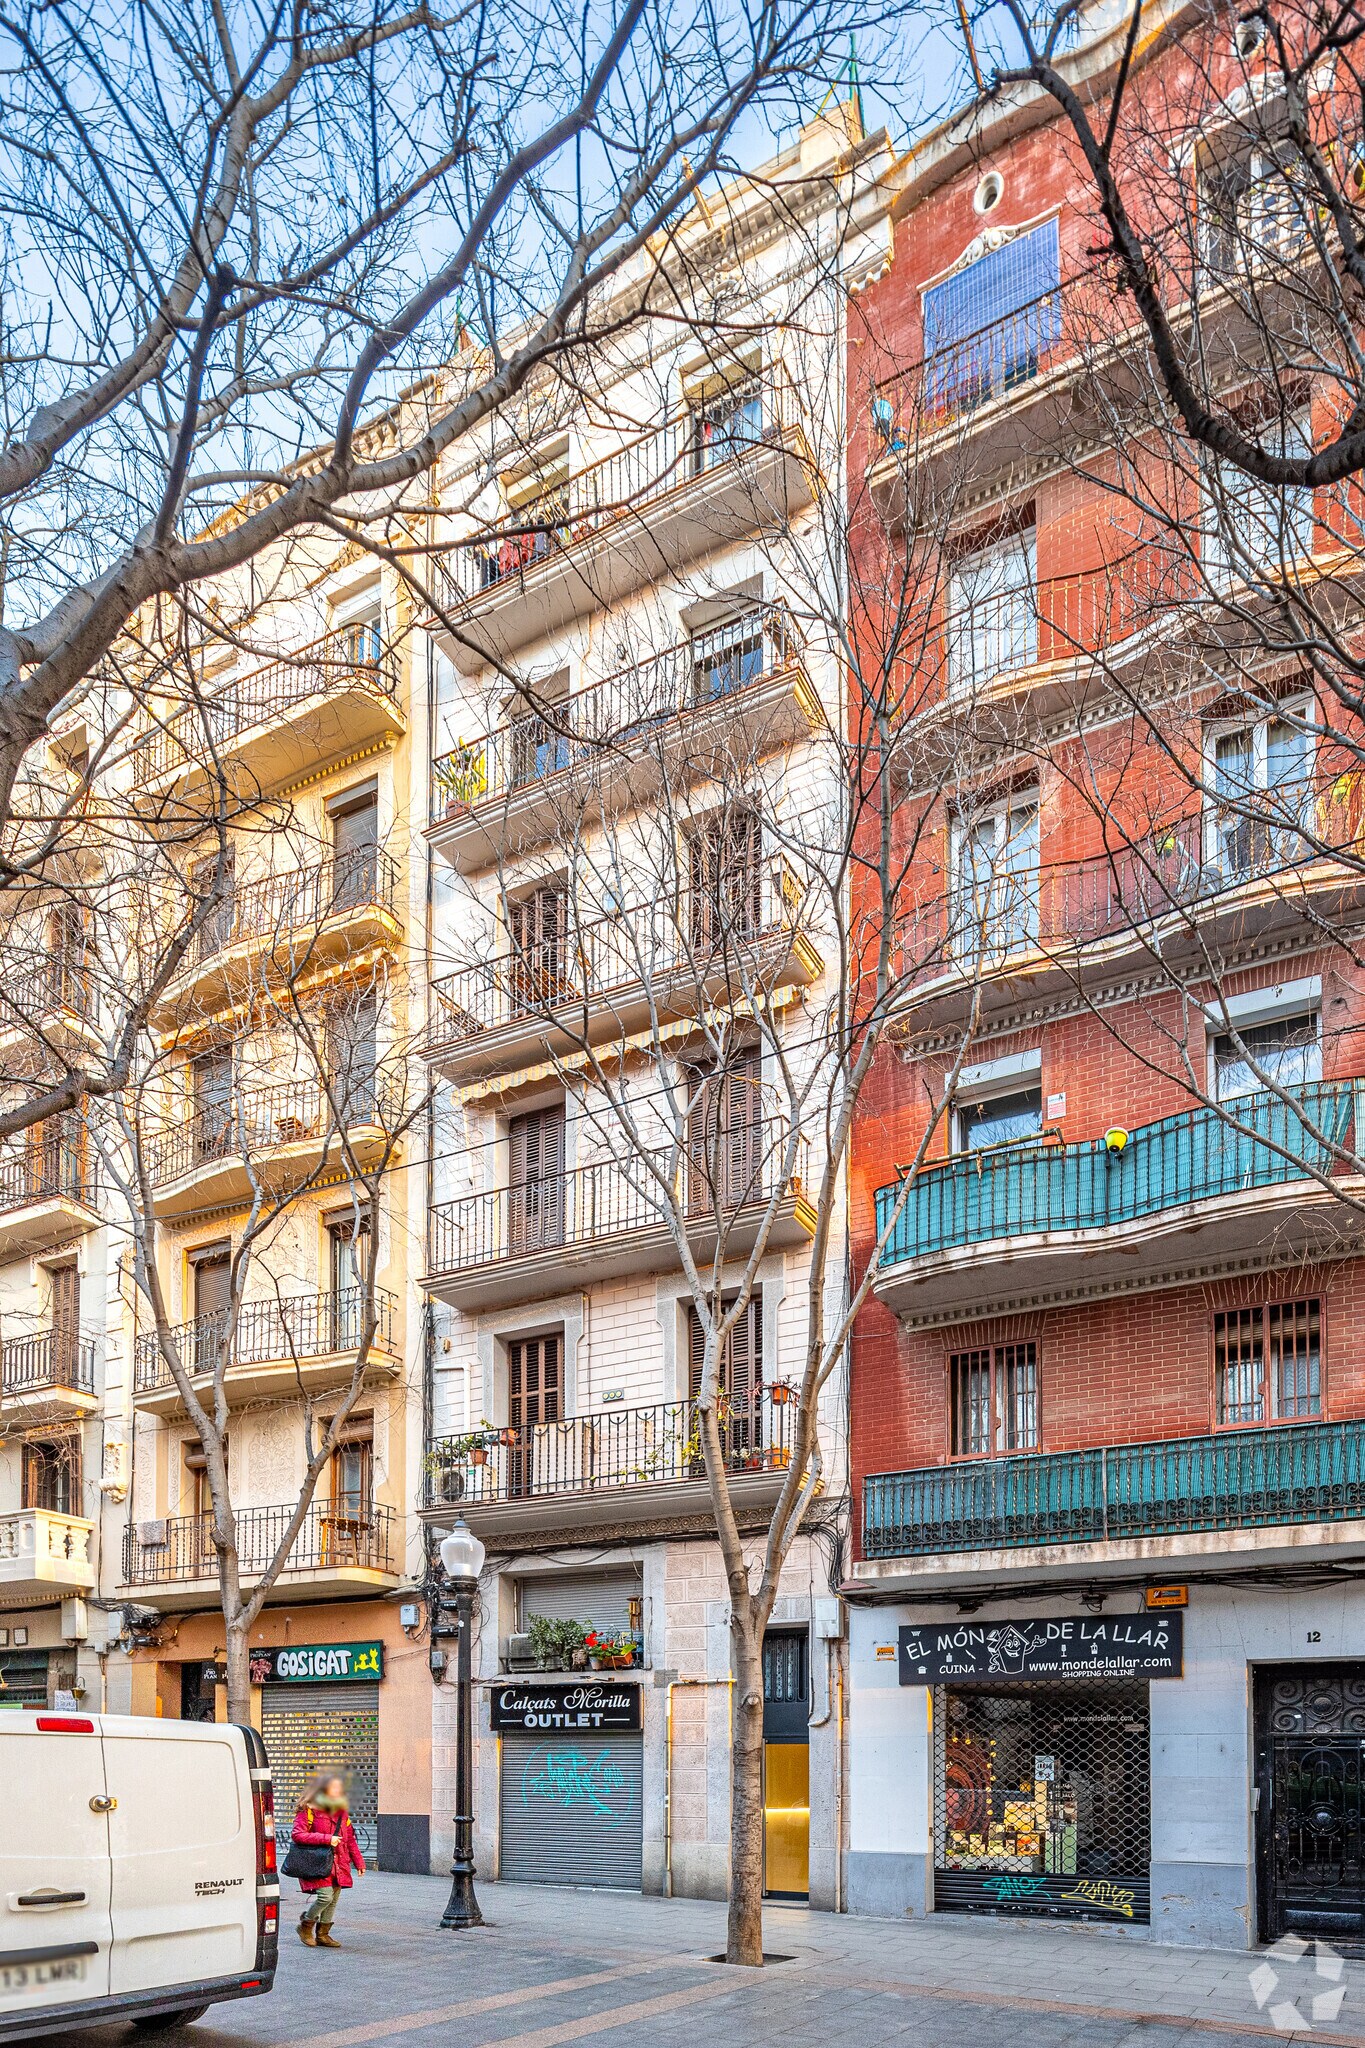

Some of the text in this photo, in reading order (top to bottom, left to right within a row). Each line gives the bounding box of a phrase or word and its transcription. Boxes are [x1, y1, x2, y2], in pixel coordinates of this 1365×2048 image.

[906, 1641, 931, 1660] EL
[937, 1625, 985, 1652] MÓN
[1046, 1622, 1074, 1640] DE
[1080, 1623, 1107, 1640] LA
[1112, 1624, 1169, 1650] LLAR
[1306, 1631, 1321, 1643] 12
[939, 1664, 976, 1674] CUINA
[1029, 1656, 1172, 1672] www.mondelallar.com
[1062, 1668, 1135, 1678] SHOPPING ONLINE
[500, 1686, 631, 1712] Calçats Morilla
[524, 1712, 604, 1728] OUTLET
[194, 1878, 244, 1889] RENAULT
[194, 1888, 225, 1897] TECH
